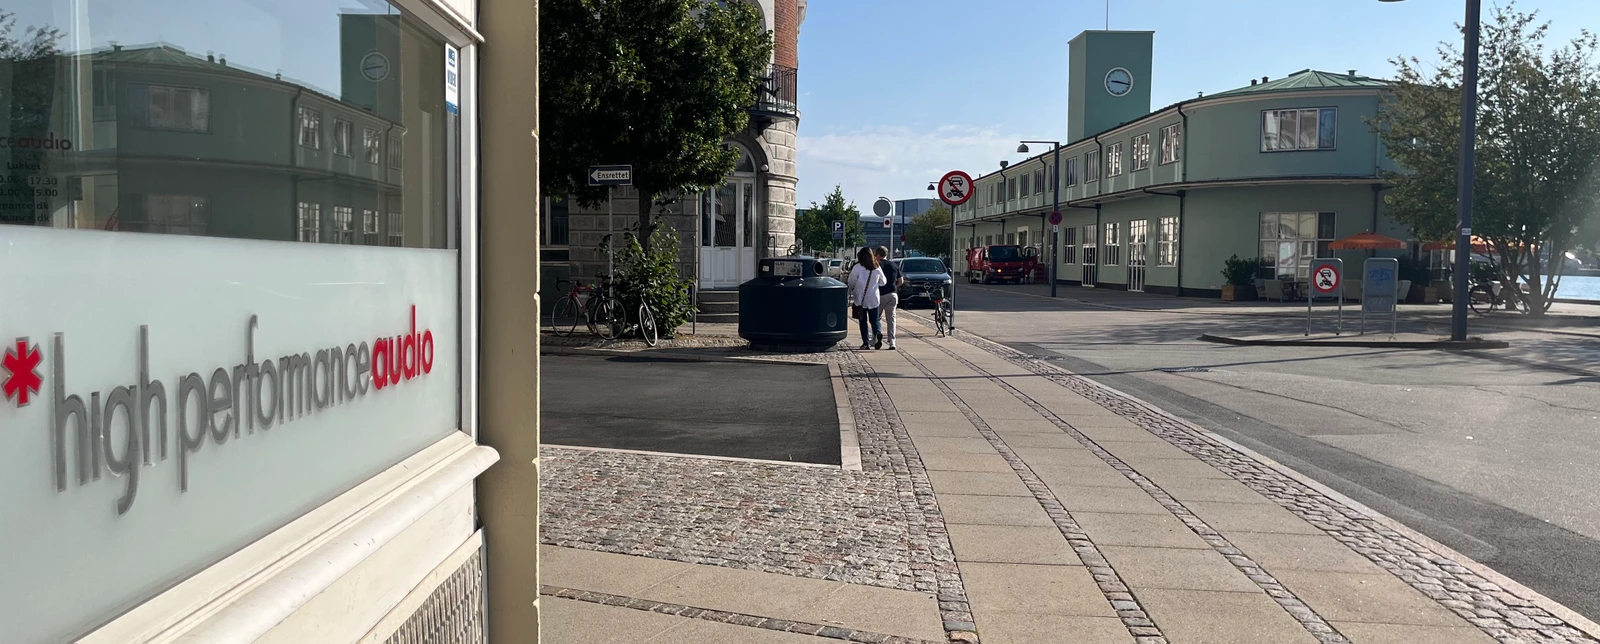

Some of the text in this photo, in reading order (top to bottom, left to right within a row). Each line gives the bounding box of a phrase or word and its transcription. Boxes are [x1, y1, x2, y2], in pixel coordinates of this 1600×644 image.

[30, 176, 58, 186] 17:30
[30, 188, 58, 197] 15.00
[834, 222, 842, 231] P
[52, 324, 167, 516] high
